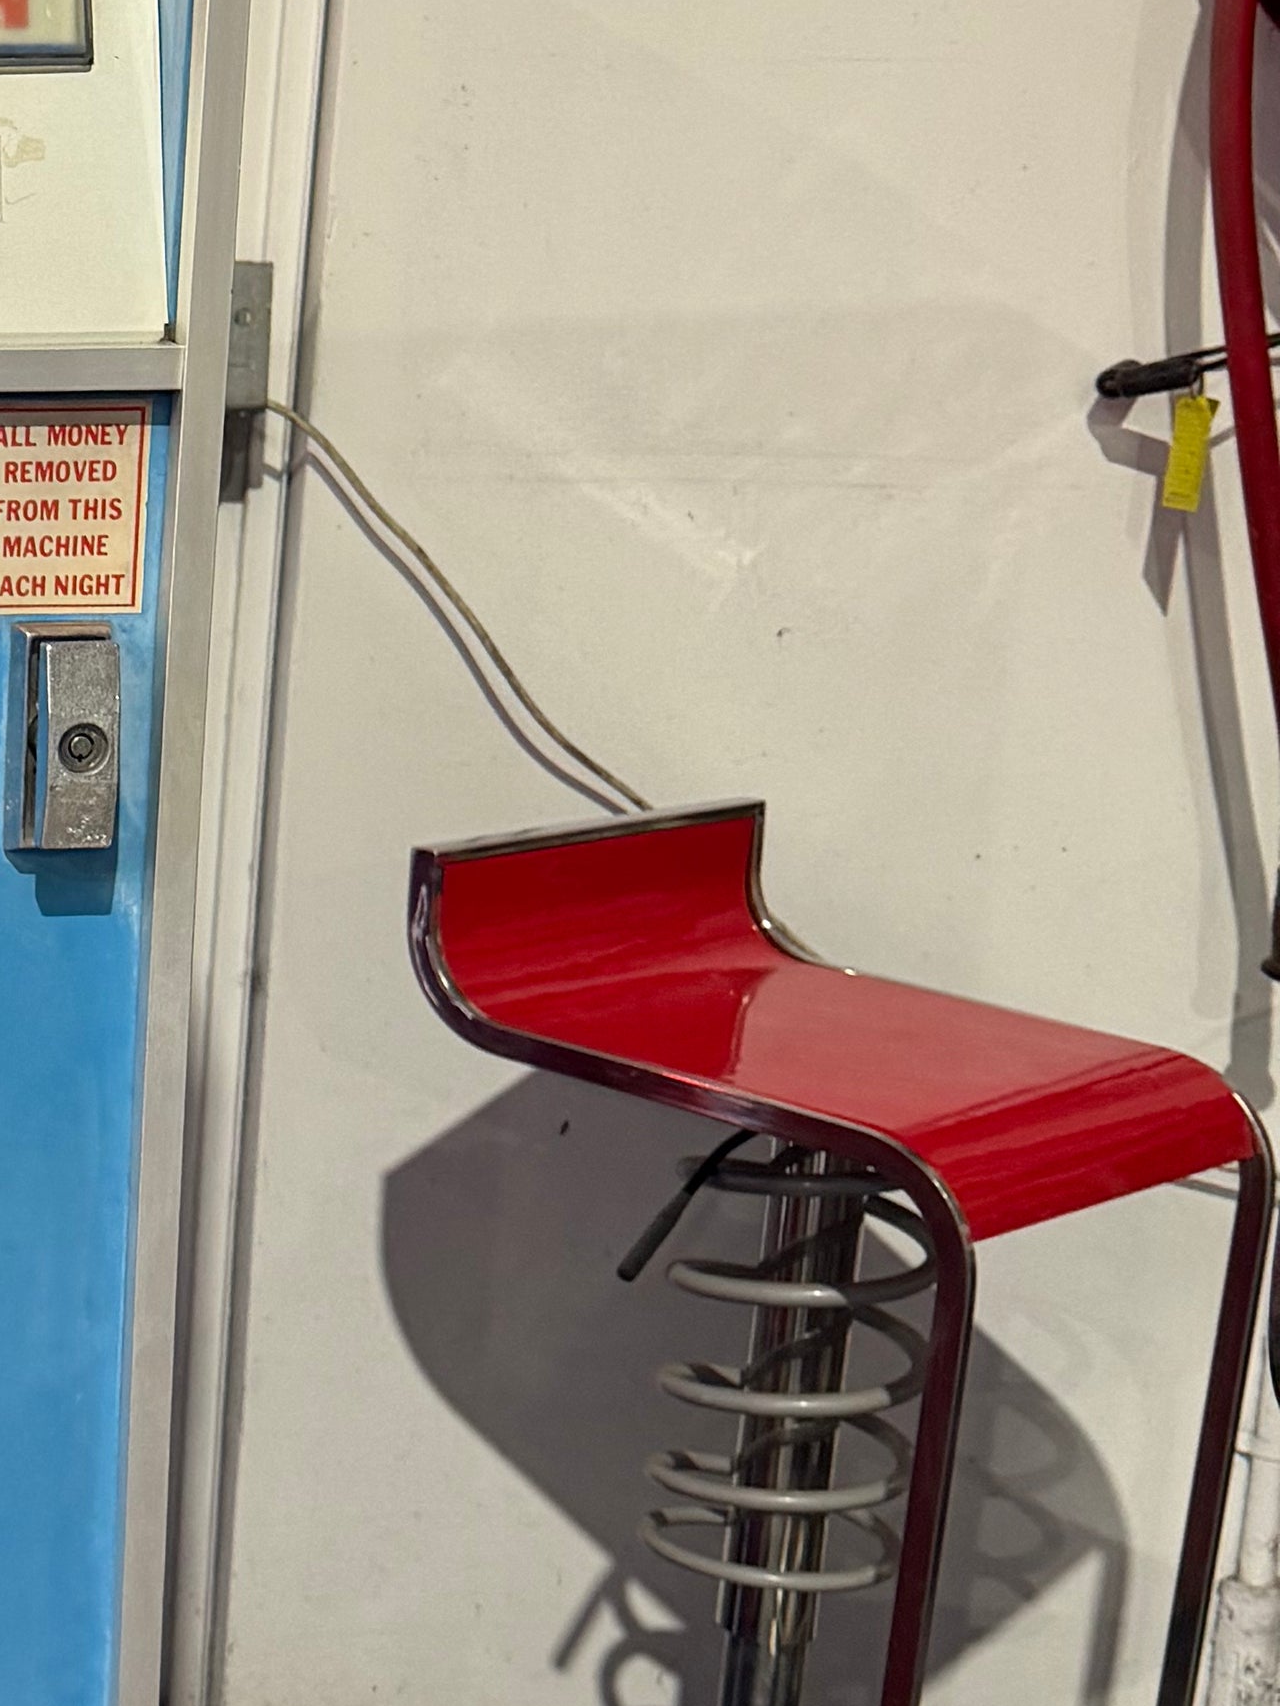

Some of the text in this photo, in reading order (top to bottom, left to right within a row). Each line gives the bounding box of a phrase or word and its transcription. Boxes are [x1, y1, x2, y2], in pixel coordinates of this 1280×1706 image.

[47, 424, 129, 446] MONEY
[4, 460, 117, 483] REMOVED
[68, 498, 123, 521] THIS
[2, 534, 110, 558] MACHINE
[54, 574, 125, 596] NIGHT
